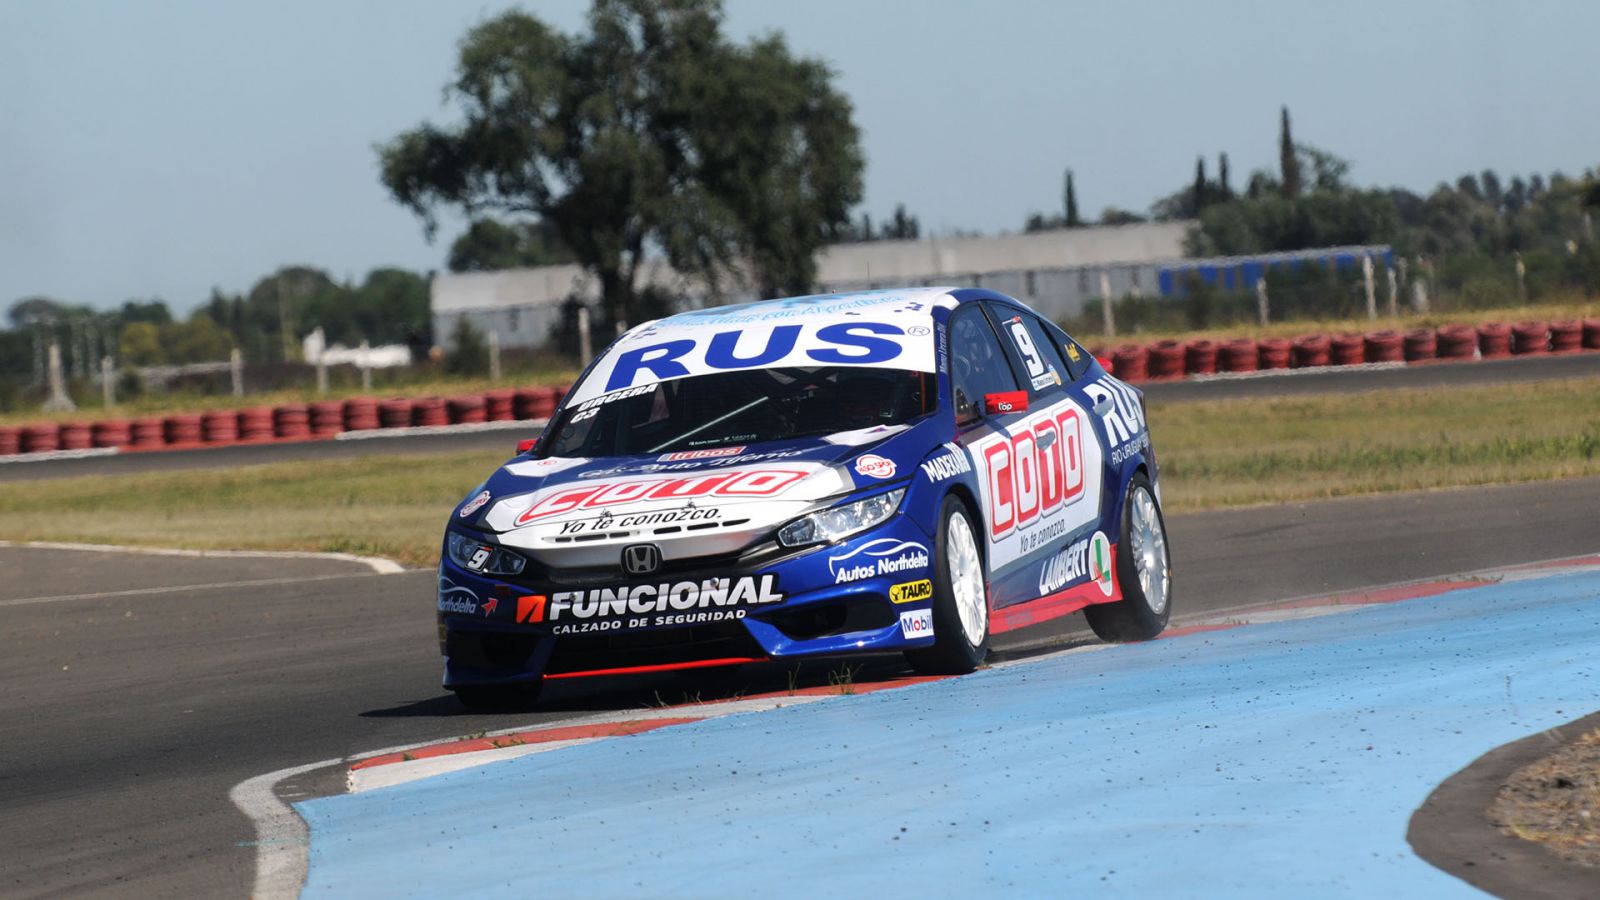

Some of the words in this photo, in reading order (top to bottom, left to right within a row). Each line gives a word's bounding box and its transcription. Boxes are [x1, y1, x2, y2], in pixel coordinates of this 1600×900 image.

[604, 322, 905, 393] RUS
[1011, 323, 1044, 377] 9
[577, 383, 658, 412] URCERA
[570, 407, 600, 424] C3
[984, 408, 1084, 536] COTO
[518, 470, 811, 524] COTO
[559, 520, 580, 535] Yo
[591, 518, 610, 531] te
[619, 508, 722, 527] conozco.
[467, 549, 490, 570] 9
[835, 565, 875, 584] Autos
[877, 551, 928, 575] Northdelta
[1039, 538, 1088, 596] LAMBERT
[550, 574, 783, 621] FUNCIONAL
[901, 582, 931, 600] TAURO
[553, 620, 621, 635] CALZADO
[628, 617, 648, 628] DE
[655, 609, 746, 627] SEGURIDAD
[903, 615, 932, 633] Mobil
